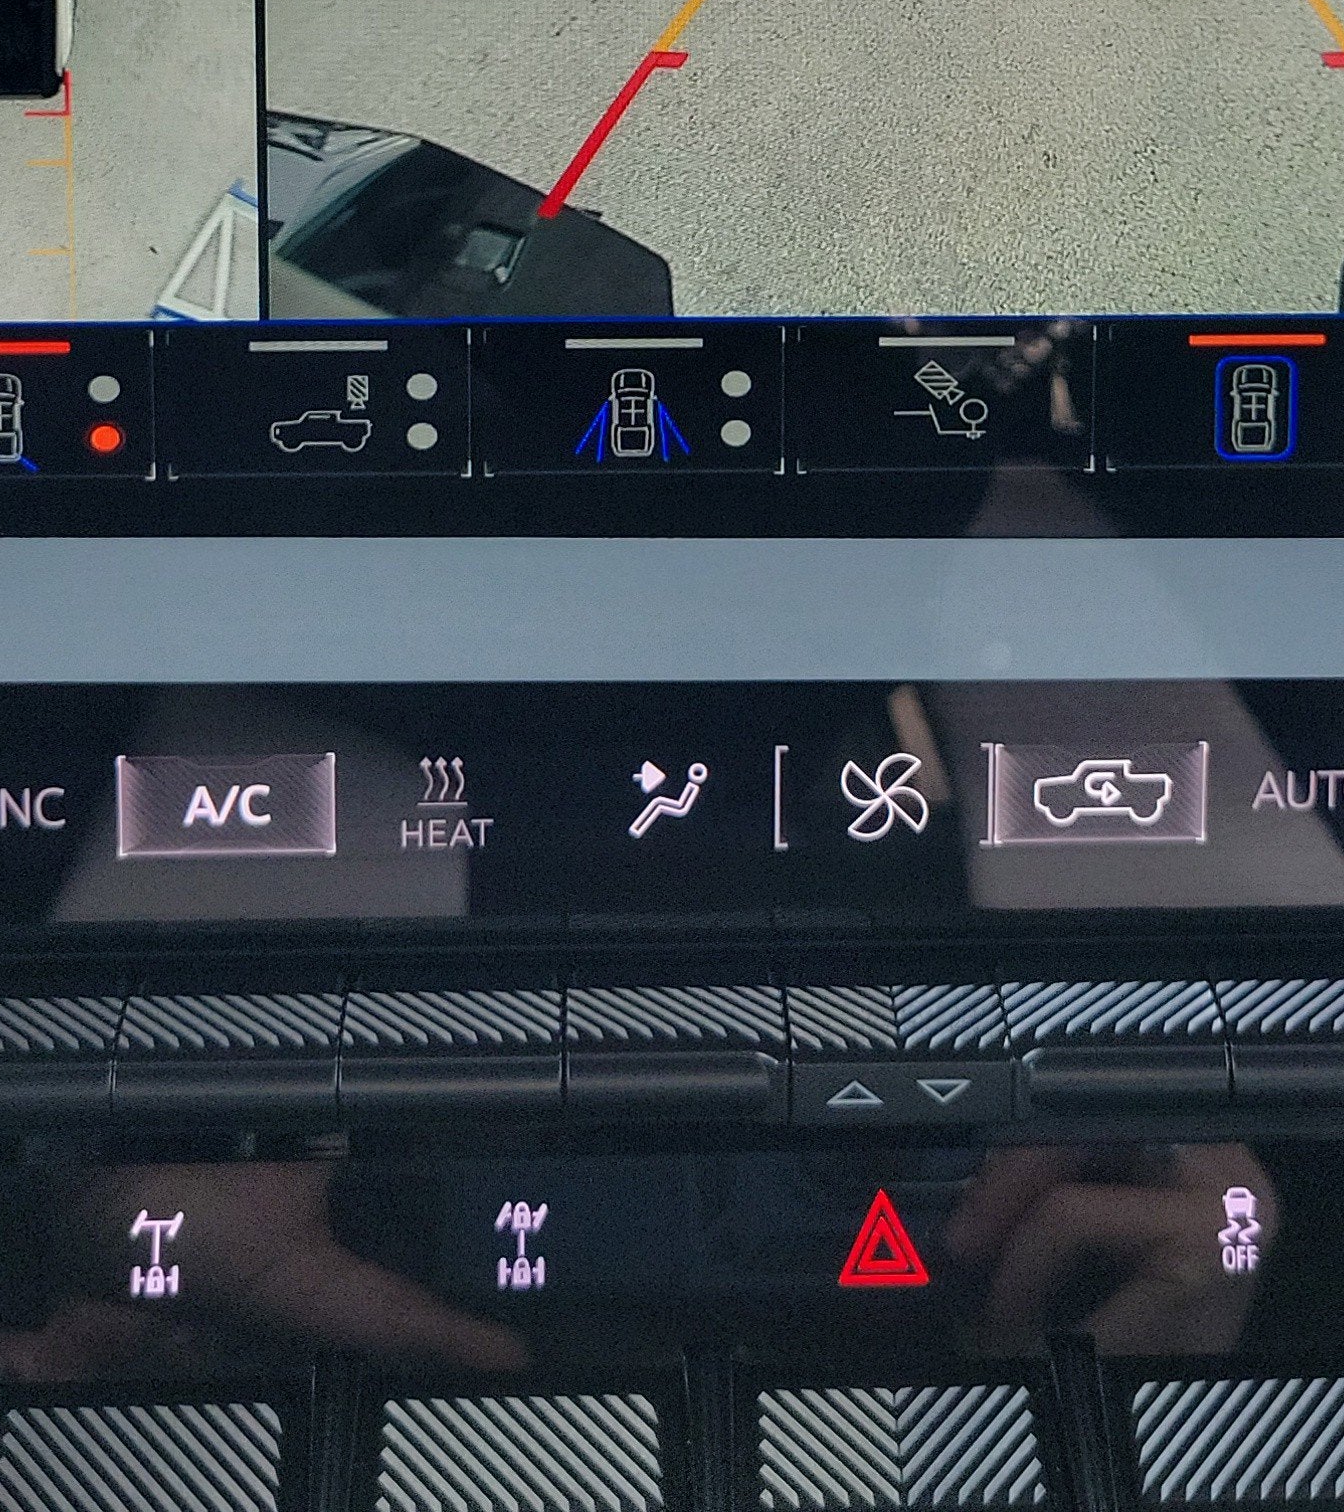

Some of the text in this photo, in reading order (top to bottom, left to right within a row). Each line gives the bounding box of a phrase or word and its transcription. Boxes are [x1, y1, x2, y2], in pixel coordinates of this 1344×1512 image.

[183, 784, 272, 828] A/C
[400, 818, 494, 849] HEAT
[1222, 1244, 1260, 1273] OFF
